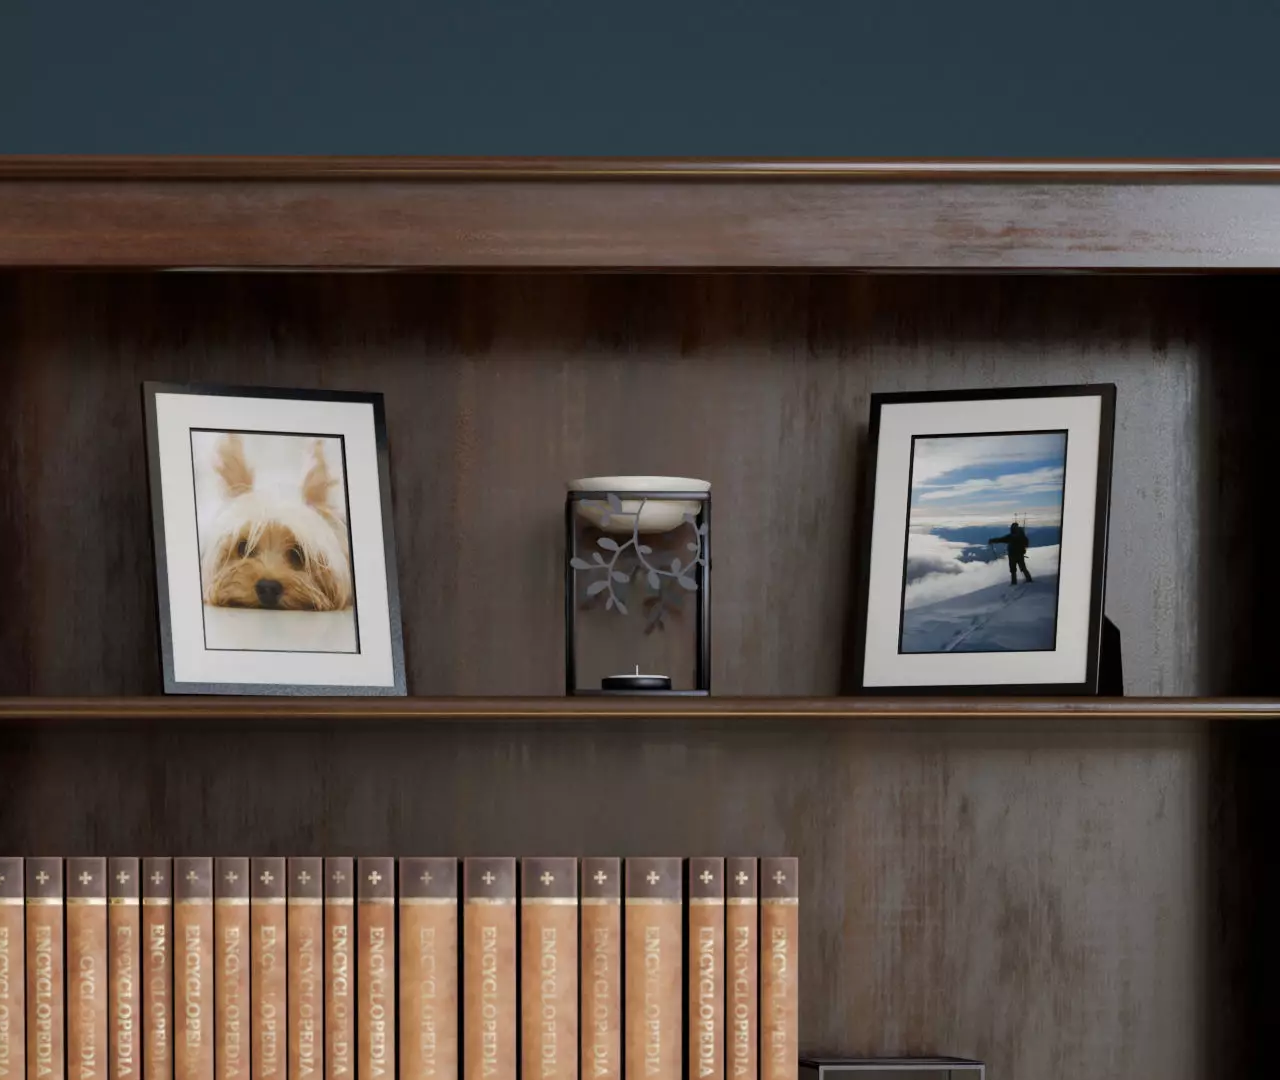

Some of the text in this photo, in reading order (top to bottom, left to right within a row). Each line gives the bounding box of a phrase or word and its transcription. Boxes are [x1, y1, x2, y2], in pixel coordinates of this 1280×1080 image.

[35, 925, 53, 1078] ENCYCLOPEDIA
[150, 923, 166, 1074] ENCYCLOPEDI
[224, 926, 240, 1079] ENCYCLOPEDIA
[260, 925, 276, 1078] ENCYLOPEDIA
[370, 927, 386, 1078] ENCYCLOPEDIA
[482, 926, 498, 1078] ENCYCLOPEDIA
[540, 928, 557, 1079] ENCYCLOPEDIA
[699, 926, 715, 1079] ENCYCLOPEDIA
